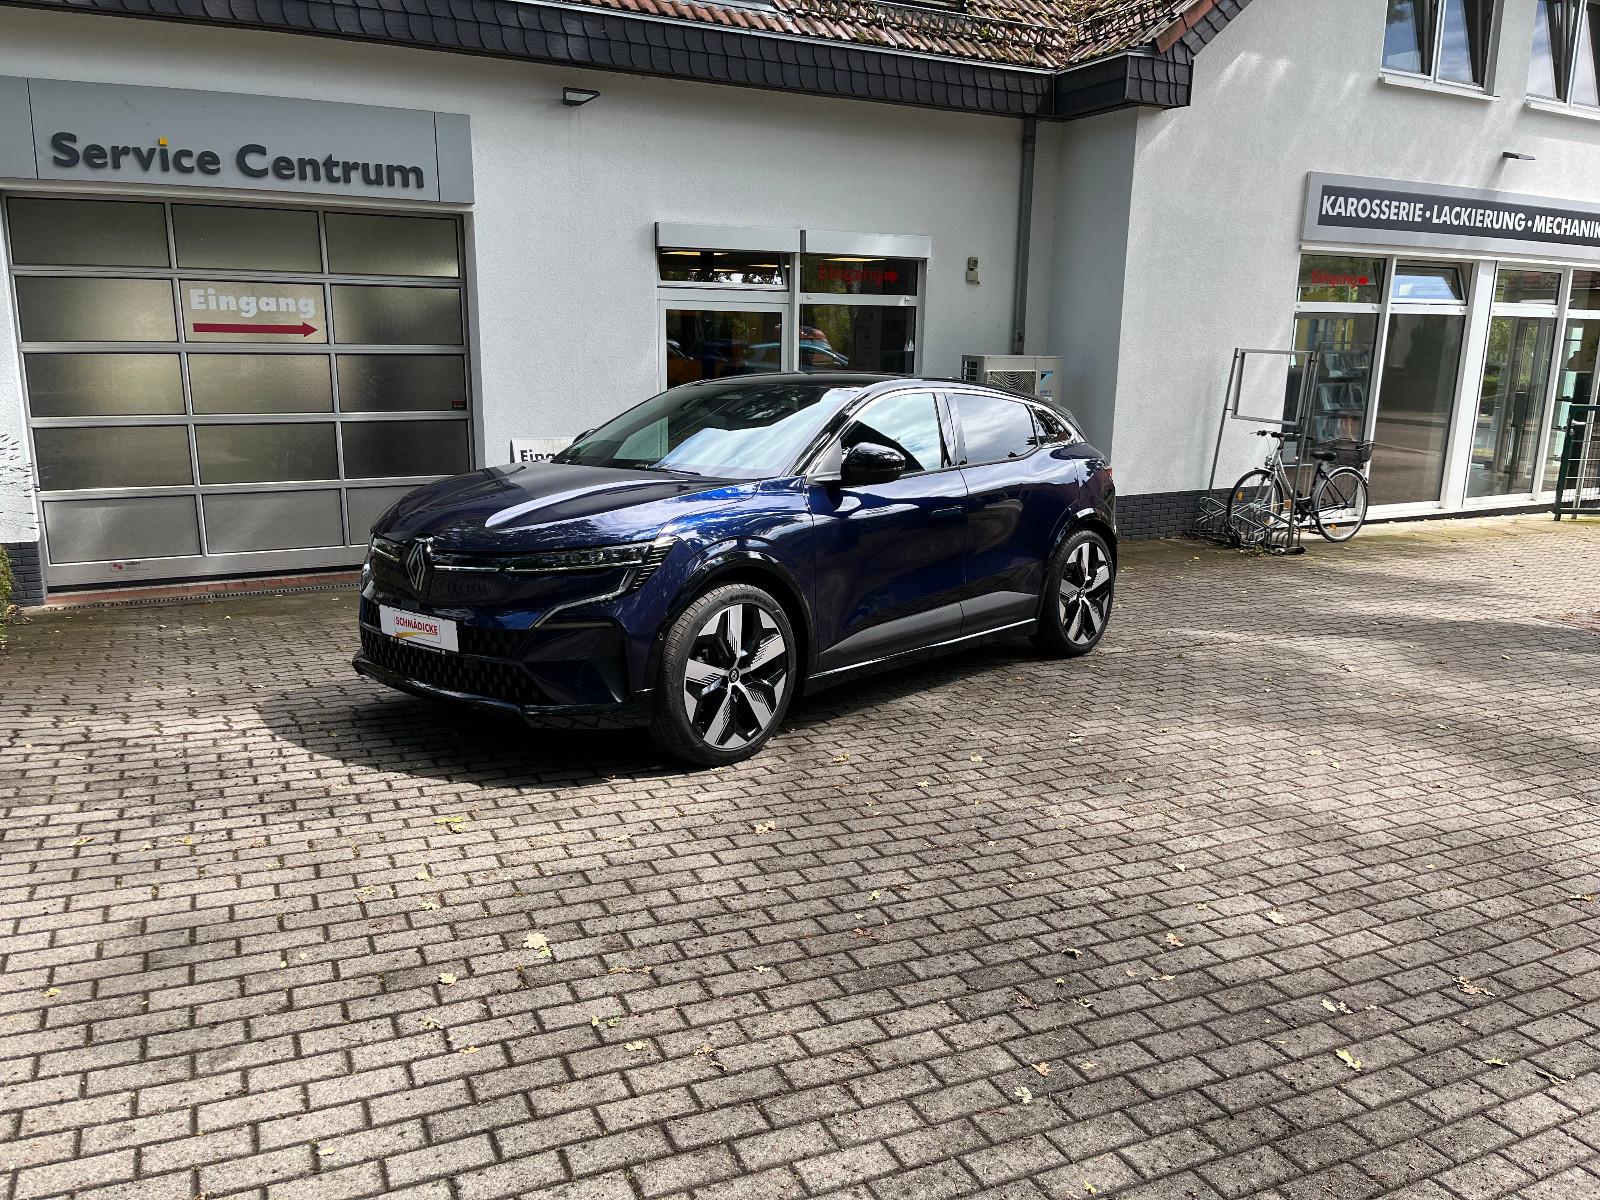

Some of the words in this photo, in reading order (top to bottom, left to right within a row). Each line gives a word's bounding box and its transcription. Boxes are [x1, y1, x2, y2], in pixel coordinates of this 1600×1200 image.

[50, 132, 221, 176] Service
[236, 143, 425, 189] Centrum
[1321, 195, 1424, 222] KAROSSERIE
[1432, 204, 1526, 232] LACKIERUNG
[189, 288, 316, 319] Eingang
